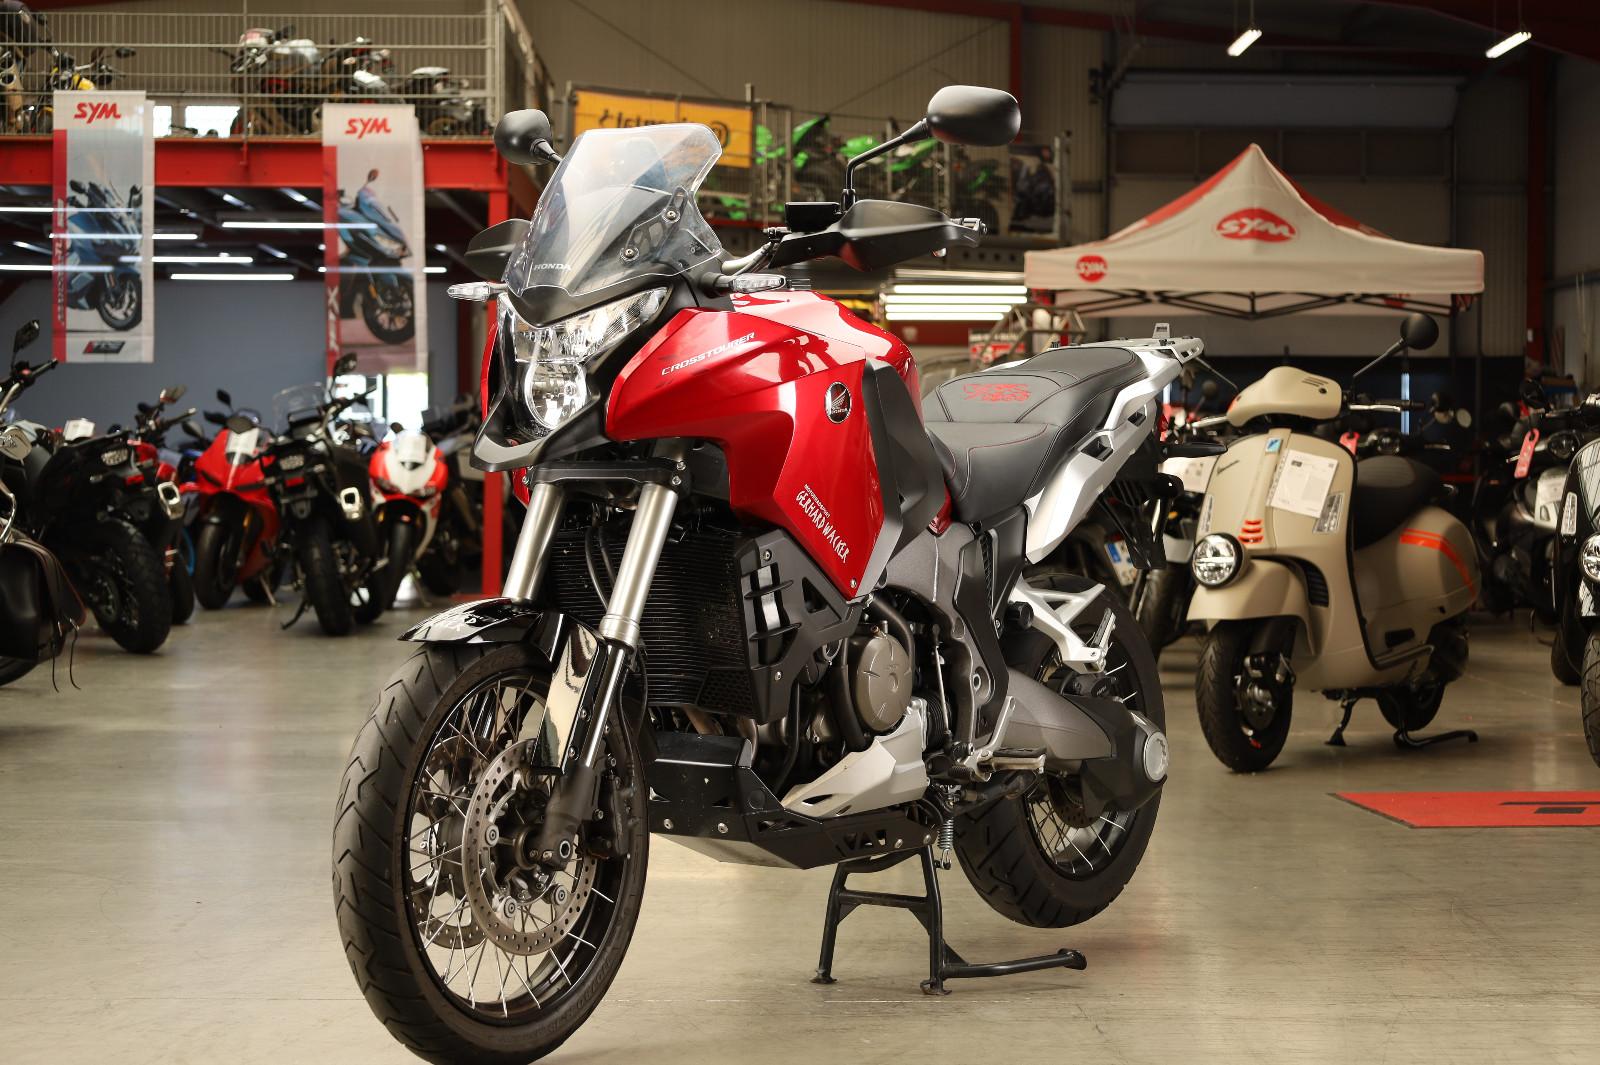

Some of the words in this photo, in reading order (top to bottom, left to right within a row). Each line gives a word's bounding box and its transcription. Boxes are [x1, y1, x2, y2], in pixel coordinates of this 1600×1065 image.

[74, 102, 122, 124] SYM
[345, 117, 392, 139] SYM
[1217, 217, 1296, 237] SYM
[533, 263, 571, 271] HONDA
[661, 332, 755, 376] CROSSTOURER
[796, 490, 826, 530] GERHARD
[822, 521, 850, 564] WACKER
